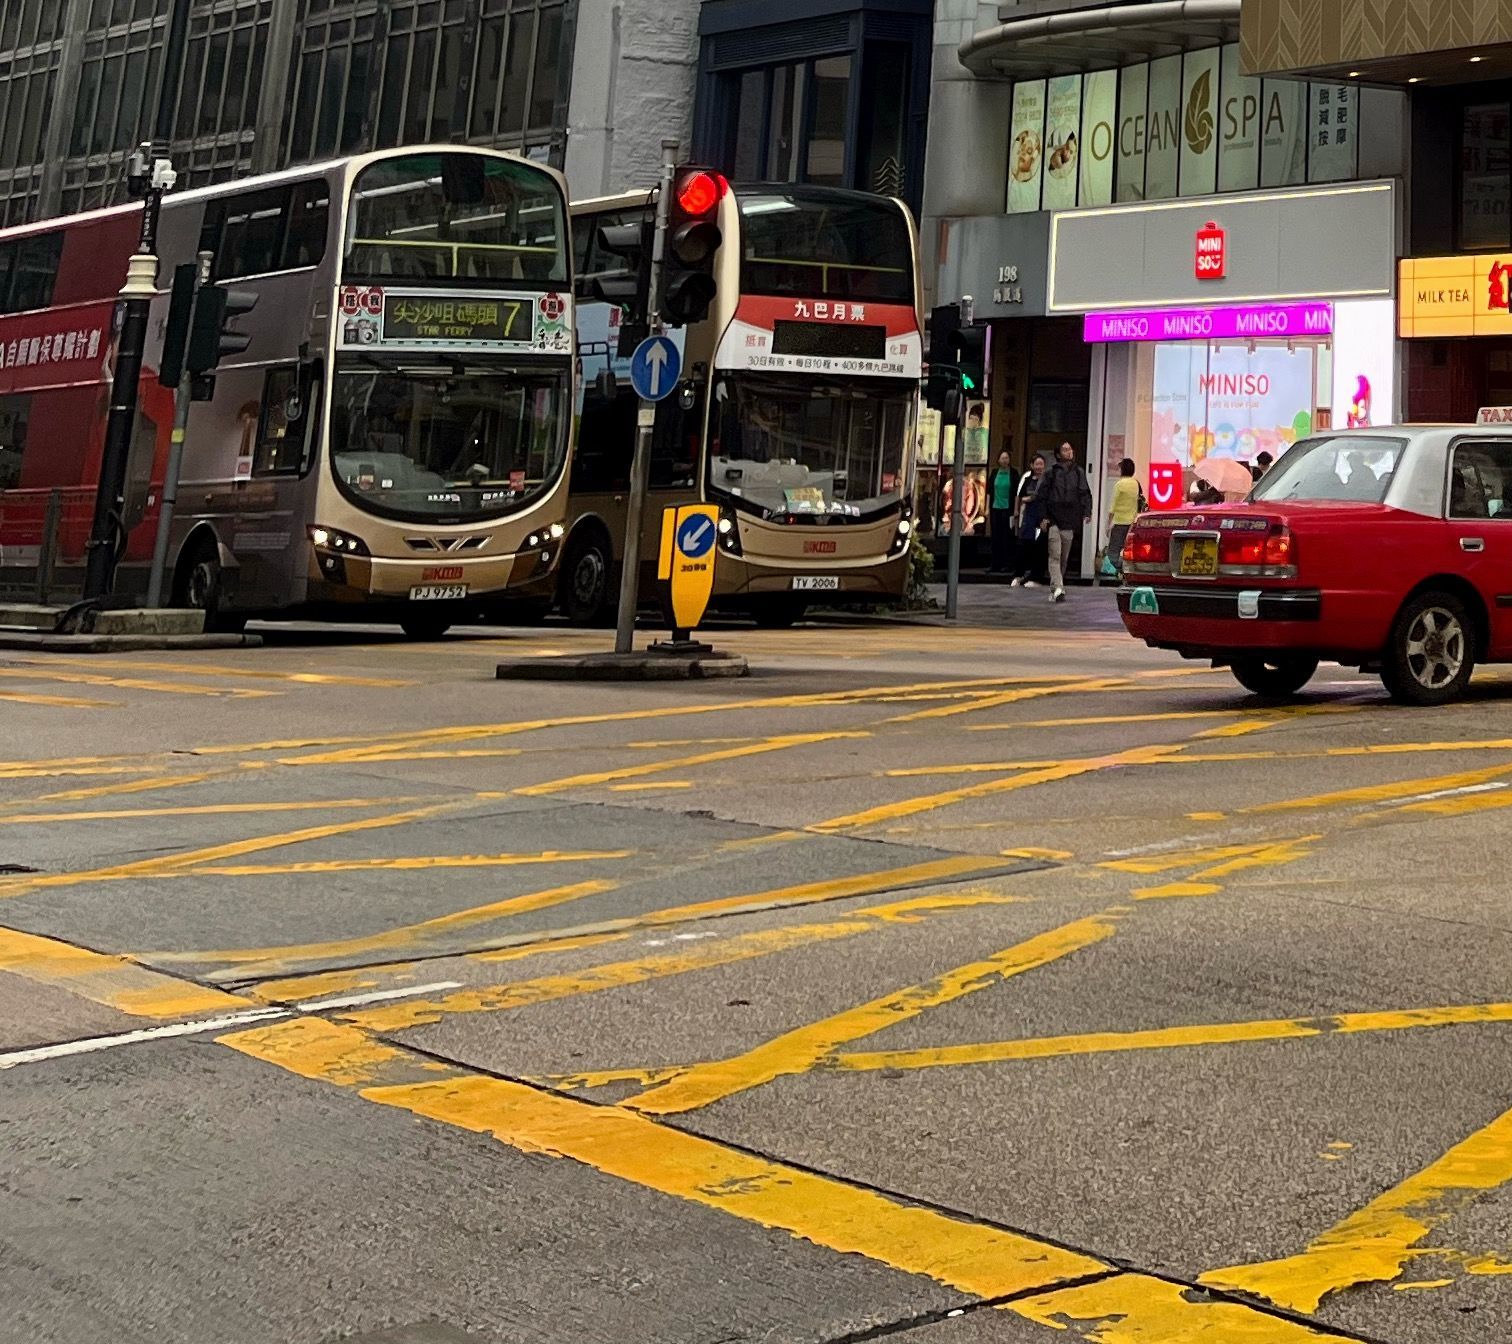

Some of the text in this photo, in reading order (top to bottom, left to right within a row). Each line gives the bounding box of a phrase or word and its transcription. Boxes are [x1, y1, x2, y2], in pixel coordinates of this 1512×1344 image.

[1091, 107, 1179, 162] OCEAN
[1224, 91, 1286, 142] SPA
[1198, 238, 1221, 252] MINI
[998, 266, 1018, 282] 198
[1417, 289, 1469, 303] MILK TEA
[794, 300, 865, 321] 九巴月票
[394, 302, 521, 337] 尖沙咀碼頭 7
[1102, 318, 1149, 337] MINISO
[1163, 314, 1213, 335] MINISO
[1236, 311, 1289, 332] MINISO
[417, 326, 474, 337] STAR FERRY
[1199, 374, 1269, 396] MINISO
[795, 578, 836, 588] TV 2006
[414, 587, 463, 599] PJ 9752
